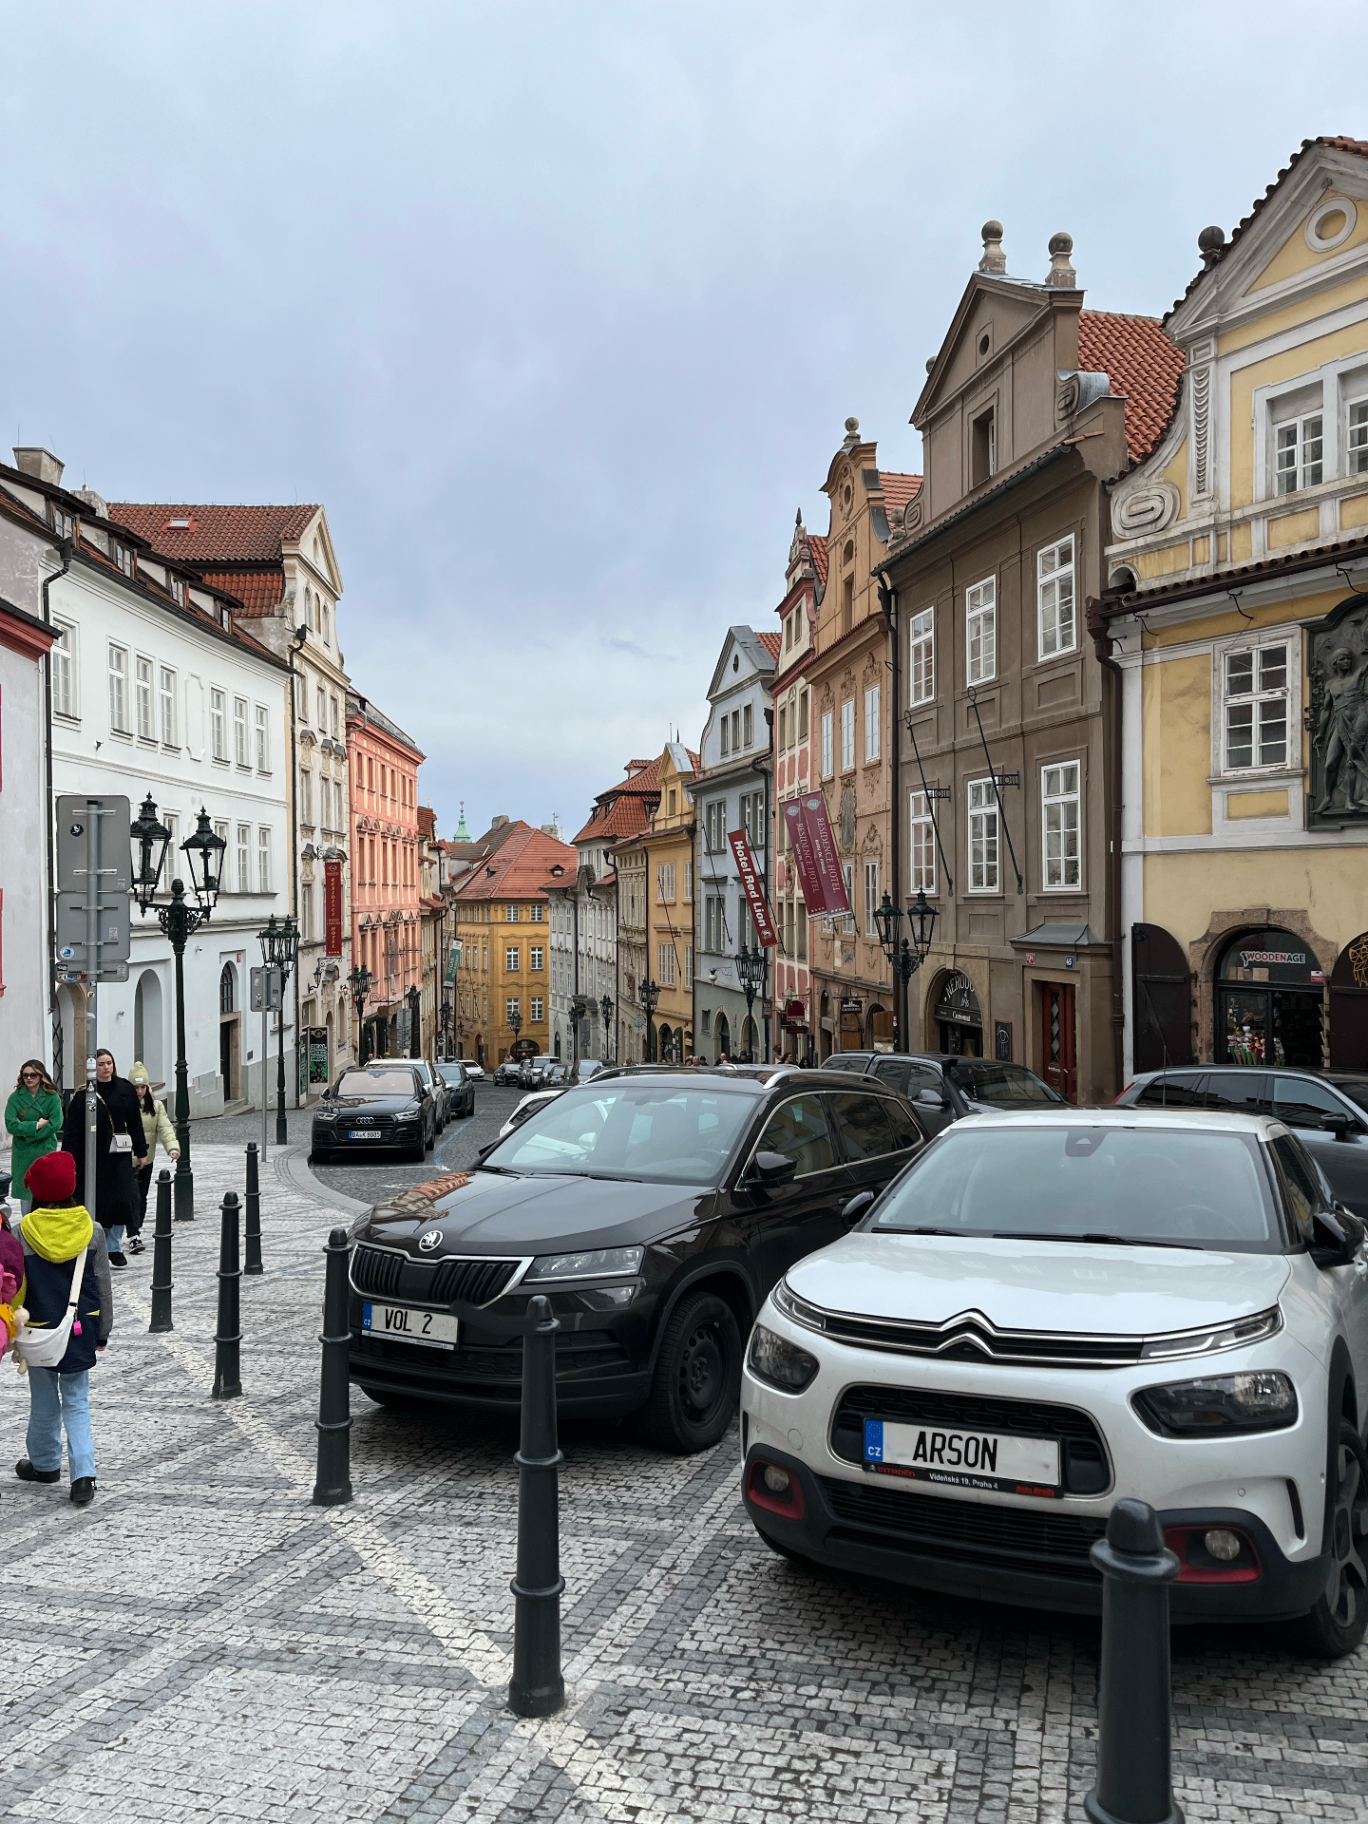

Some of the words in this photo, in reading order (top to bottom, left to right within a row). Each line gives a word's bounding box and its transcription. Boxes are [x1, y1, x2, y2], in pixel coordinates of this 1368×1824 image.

[796, 823, 813, 866] RESIDENCE
[808, 866, 820, 894] HOTEL
[816, 817, 834, 863] RESIDENCE
[827, 863, 841, 893] HOTEL
[733, 840, 752, 872] Hotel
[744, 874, 760, 899] Red
[752, 902, 767, 927] Lion
[385, 1308, 412, 1332] VOL
[421, 1313, 433, 1334] 2
[867, 1445, 882, 1457] CZ
[912, 1430, 998, 1472] ARSON
[961, 1477, 971, 1486] 19,
[972, 1479, 992, 1489] Praha
